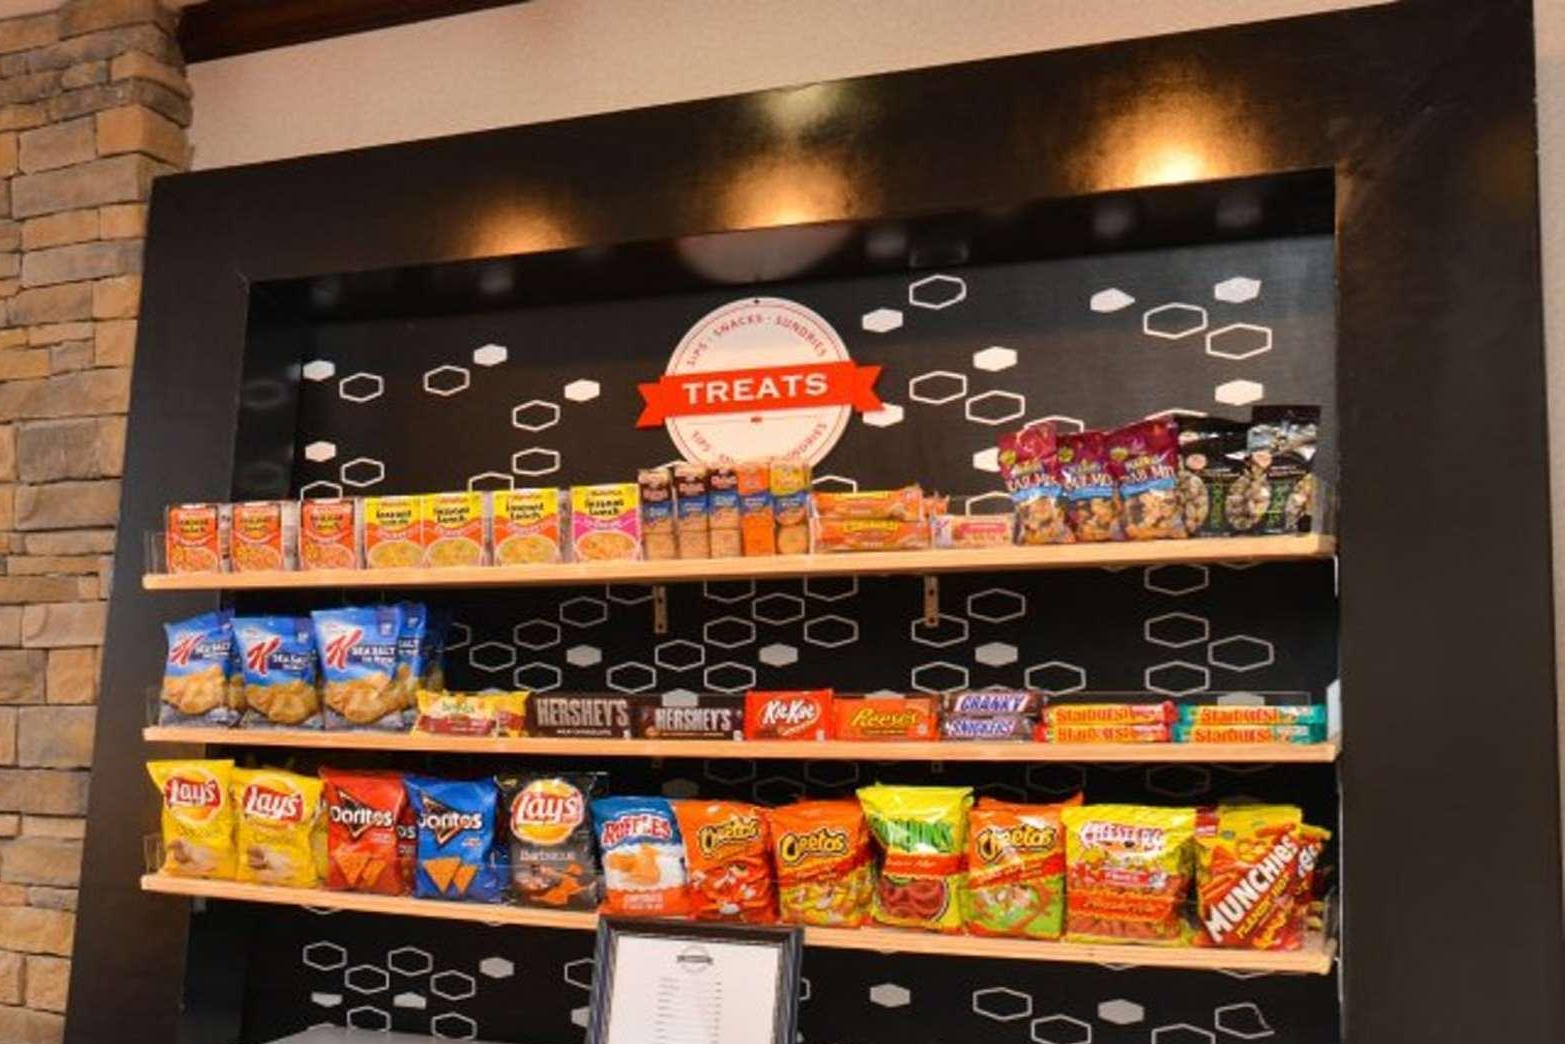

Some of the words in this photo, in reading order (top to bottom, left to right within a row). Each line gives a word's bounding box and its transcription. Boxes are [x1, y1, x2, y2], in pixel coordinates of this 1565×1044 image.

[713, 313, 763, 337] SNACKS
[775, 315, 827, 357] SUNDRIES
[682, 373, 830, 405] TREATS
[537, 699, 629, 726] HERSHEY'S
[654, 709, 732, 732] HERSHEY'S
[850, 708, 917, 728] Reese's
[330, 806, 393, 827] Doritos
[1204, 833, 1299, 943] MUNCHIES
